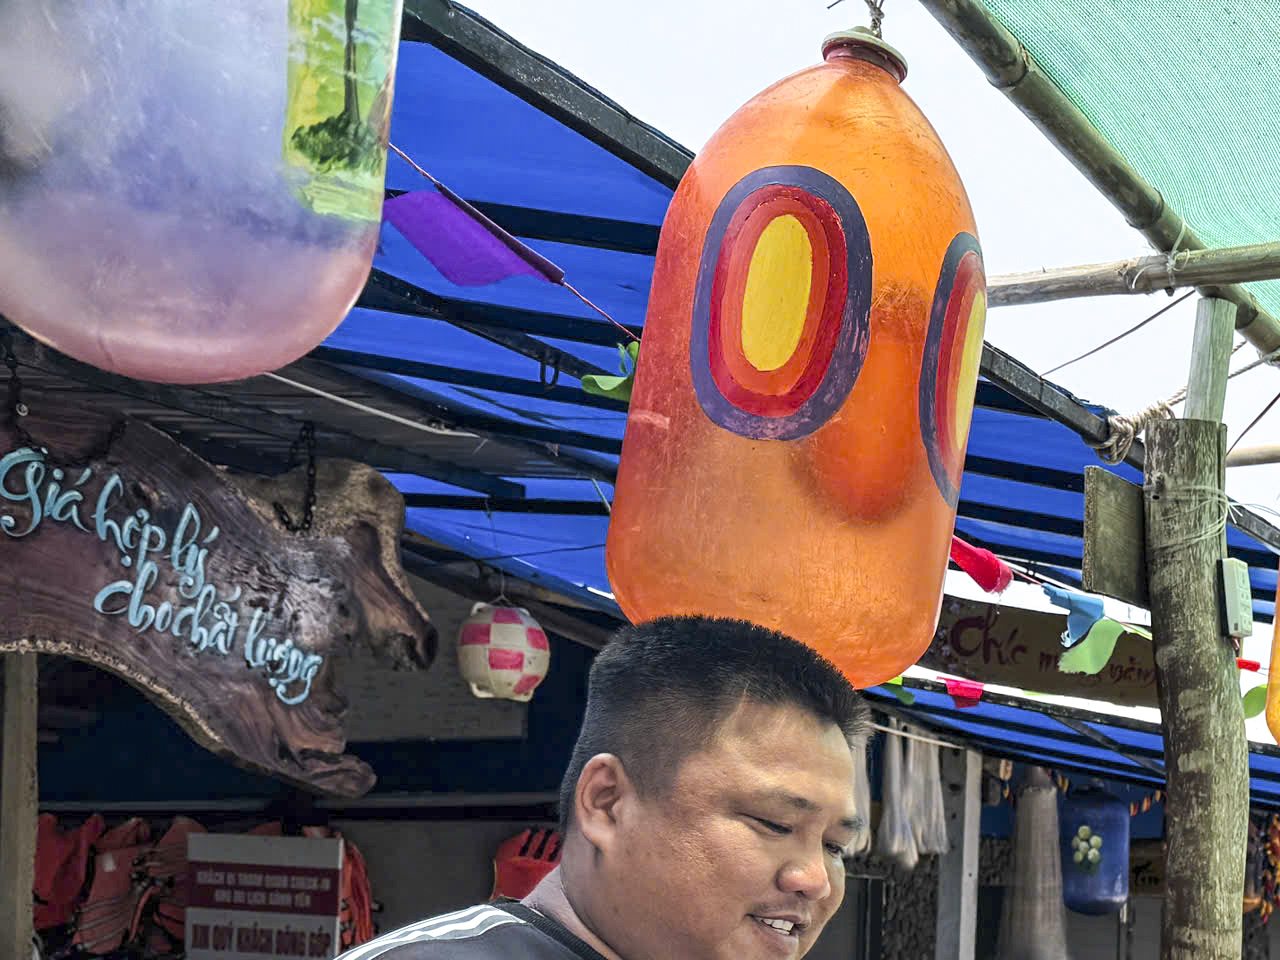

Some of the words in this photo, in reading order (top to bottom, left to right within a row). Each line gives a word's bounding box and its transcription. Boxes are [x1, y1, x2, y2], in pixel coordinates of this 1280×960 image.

[0, 447, 91, 537] Giá
[91, 474, 166, 573] hợp
[166, 503, 219, 599] lý
[172, 584, 241, 655] chất
[244, 608, 324, 705] lượng
